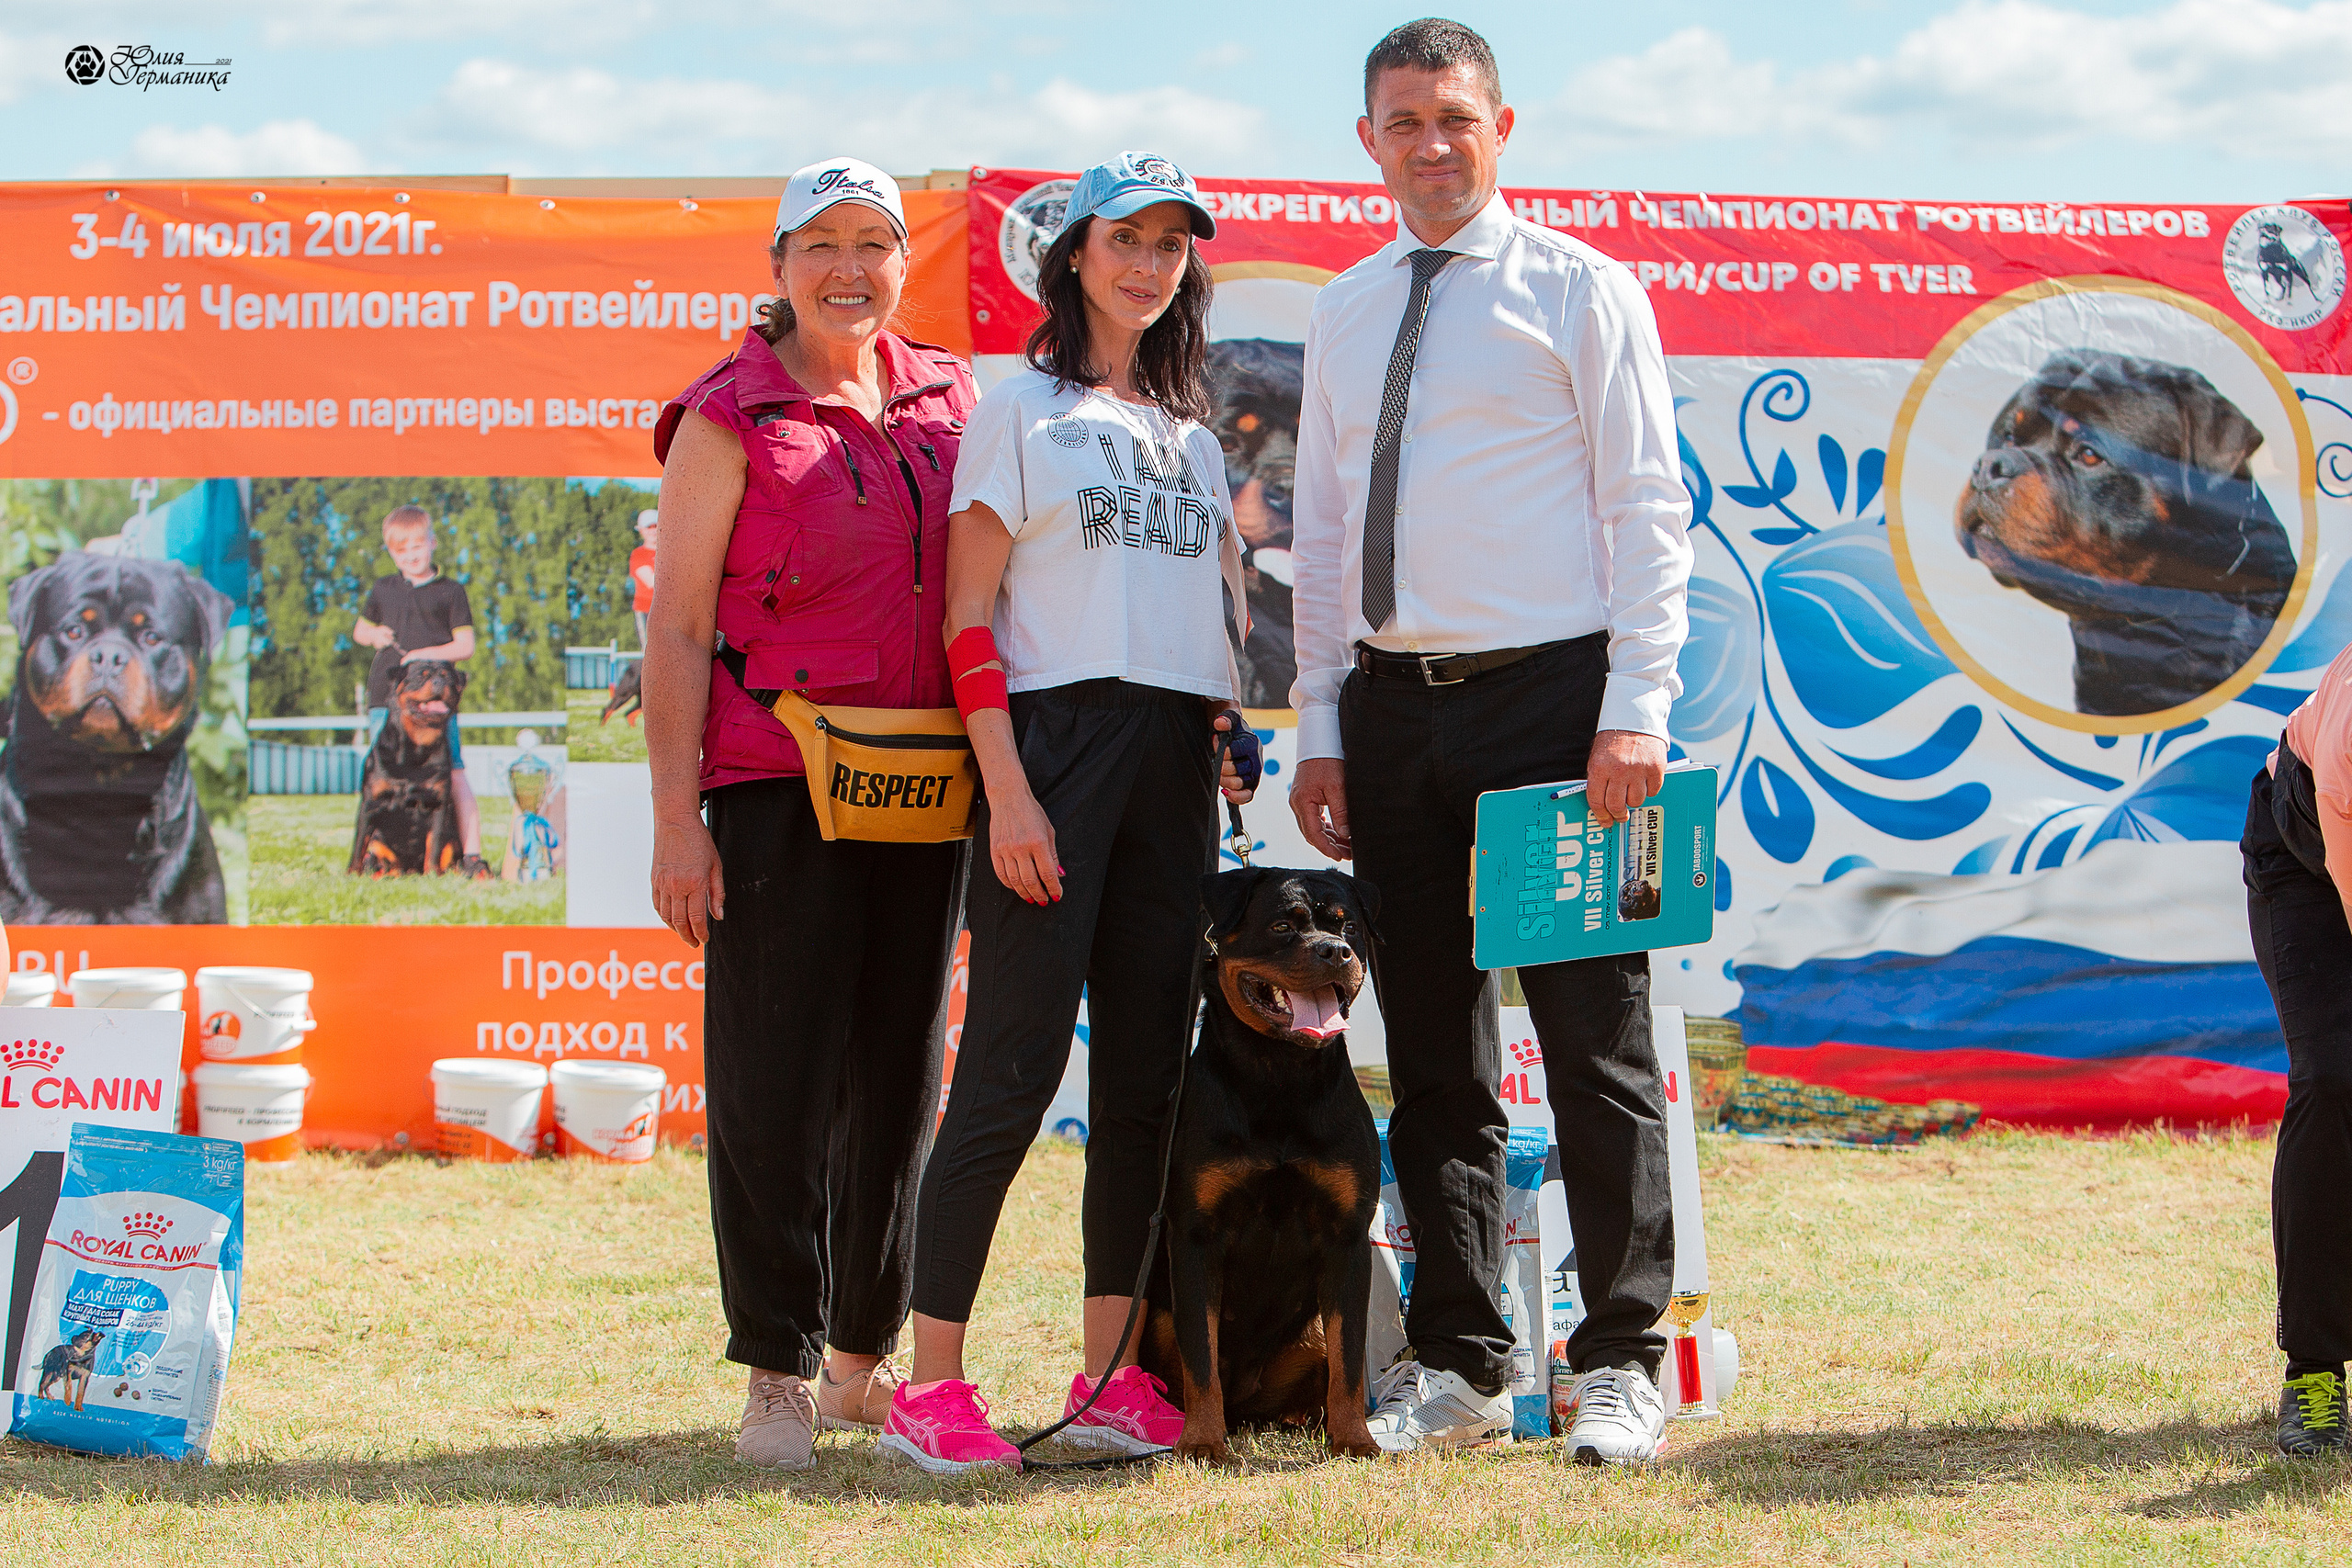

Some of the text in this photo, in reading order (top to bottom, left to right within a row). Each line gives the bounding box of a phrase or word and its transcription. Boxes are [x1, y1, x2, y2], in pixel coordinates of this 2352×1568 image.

[811, 168, 885, 198] Italia
[70, 210, 444, 260] 3-4 июля 2021г.
[1629, 199, 1905, 231] ЧЕМПИОНАТ
[1914, 202, 2211, 238] РОТВЕЙЛЕРОВ
[1807, 262, 1861, 292] OF
[1869, 263, 1977, 294] TVER
[199, 282, 475, 331] Чемпионат
[68, 392, 339, 438] официальные
[349, 397, 535, 435] партнеры
[545, 399, 673, 430] выста
[1097, 434, 1205, 498] I AM
[830, 761, 954, 809] RESPECT
[1645, 808, 1658, 876] VII Silver CUP
[1692, 825, 1702, 873] TABOOSPORT
[1585, 849, 1604, 904] Silver
[1584, 907, 1602, 932] VII
[477, 1021, 688, 1059] подход к
[31, 1077, 162, 1111] CANIN
[70, 1229, 203, 1263] ROYAL CANIN
[74, 1288, 157, 1309] ДЛЯ ЩЕНКОВ
[102, 1278, 140, 1292] PUPPY
